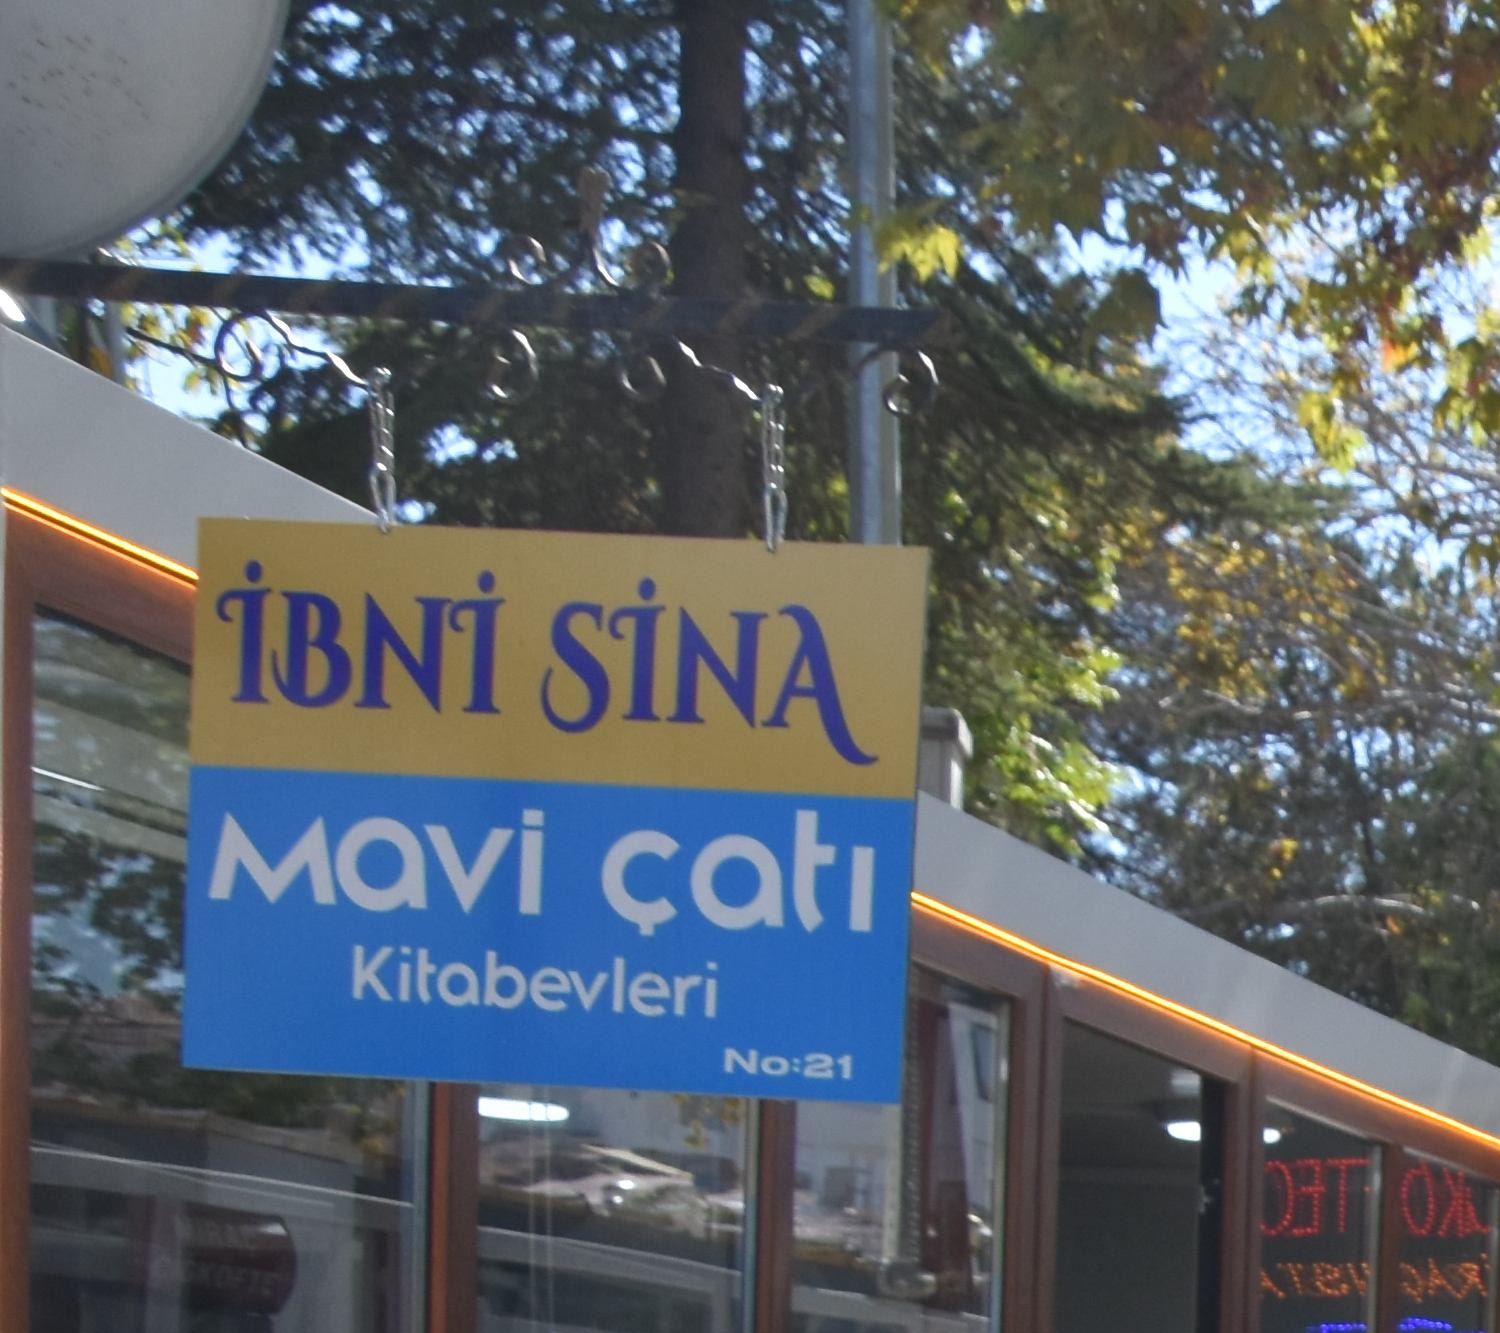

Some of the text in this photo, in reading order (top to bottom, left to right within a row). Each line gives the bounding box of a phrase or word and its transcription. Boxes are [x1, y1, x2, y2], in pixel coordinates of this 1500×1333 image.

[216, 560, 879, 766] İBNİ SİNA
[209, 809, 545, 914] Mavi
[352, 944, 718, 1018] Kitabevleri
[723, 1047, 852, 1079] No:21
